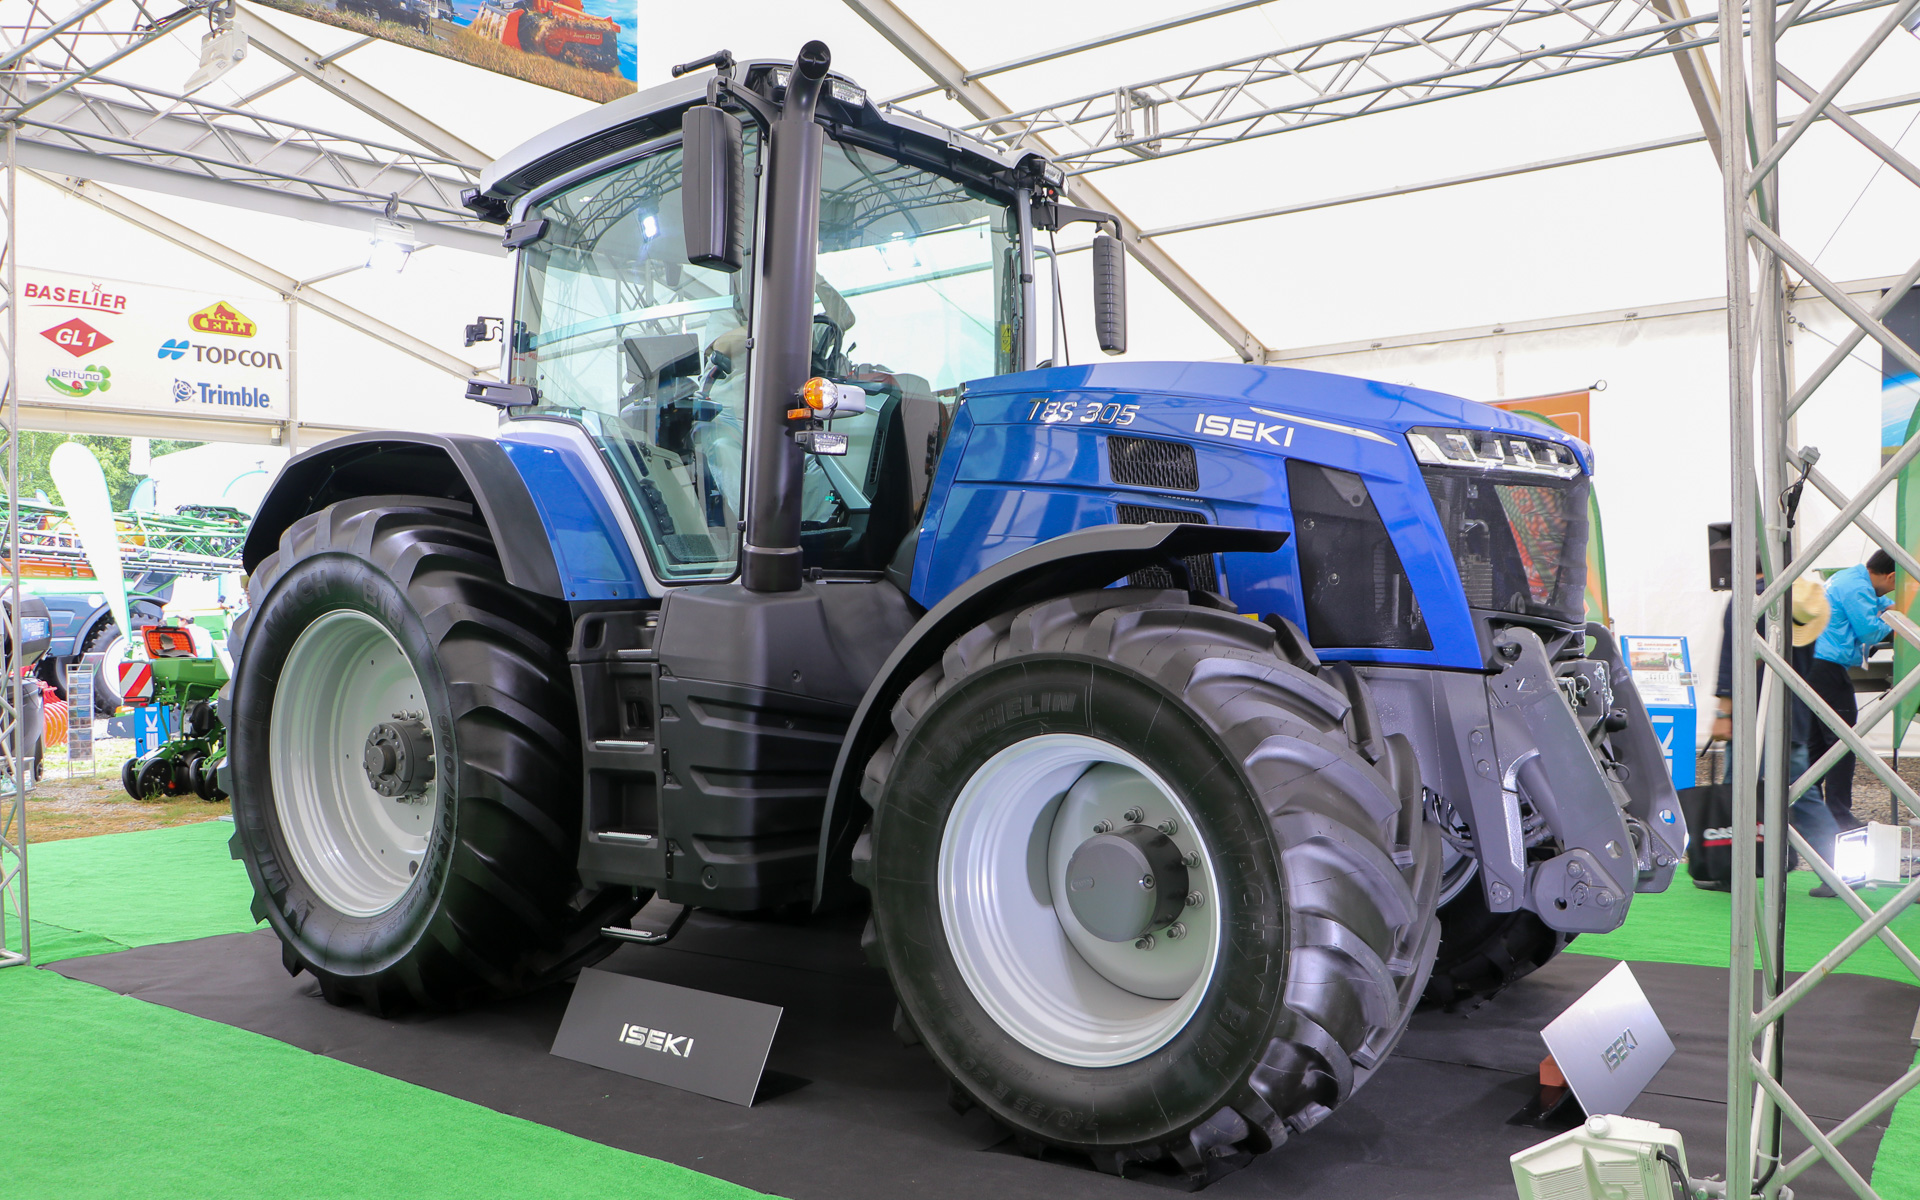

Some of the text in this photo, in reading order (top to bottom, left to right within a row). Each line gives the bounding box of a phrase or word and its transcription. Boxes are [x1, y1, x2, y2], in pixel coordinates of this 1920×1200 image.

[24, 283, 127, 310] BASELIER
[55, 328, 97, 348] GL 1
[192, 312, 252, 338] CELLI
[192, 344, 283, 370] TOPCON
[52, 367, 100, 382] Nettuno
[197, 382, 270, 408] Trimble
[1080, 402, 1141, 426] 305
[1195, 413, 1295, 447] ISEKI
[934, 691, 1077, 774] MICHELIN
[618, 1022, 695, 1058] ISEKI
[1600, 1026, 1639, 1074] ISEKI
